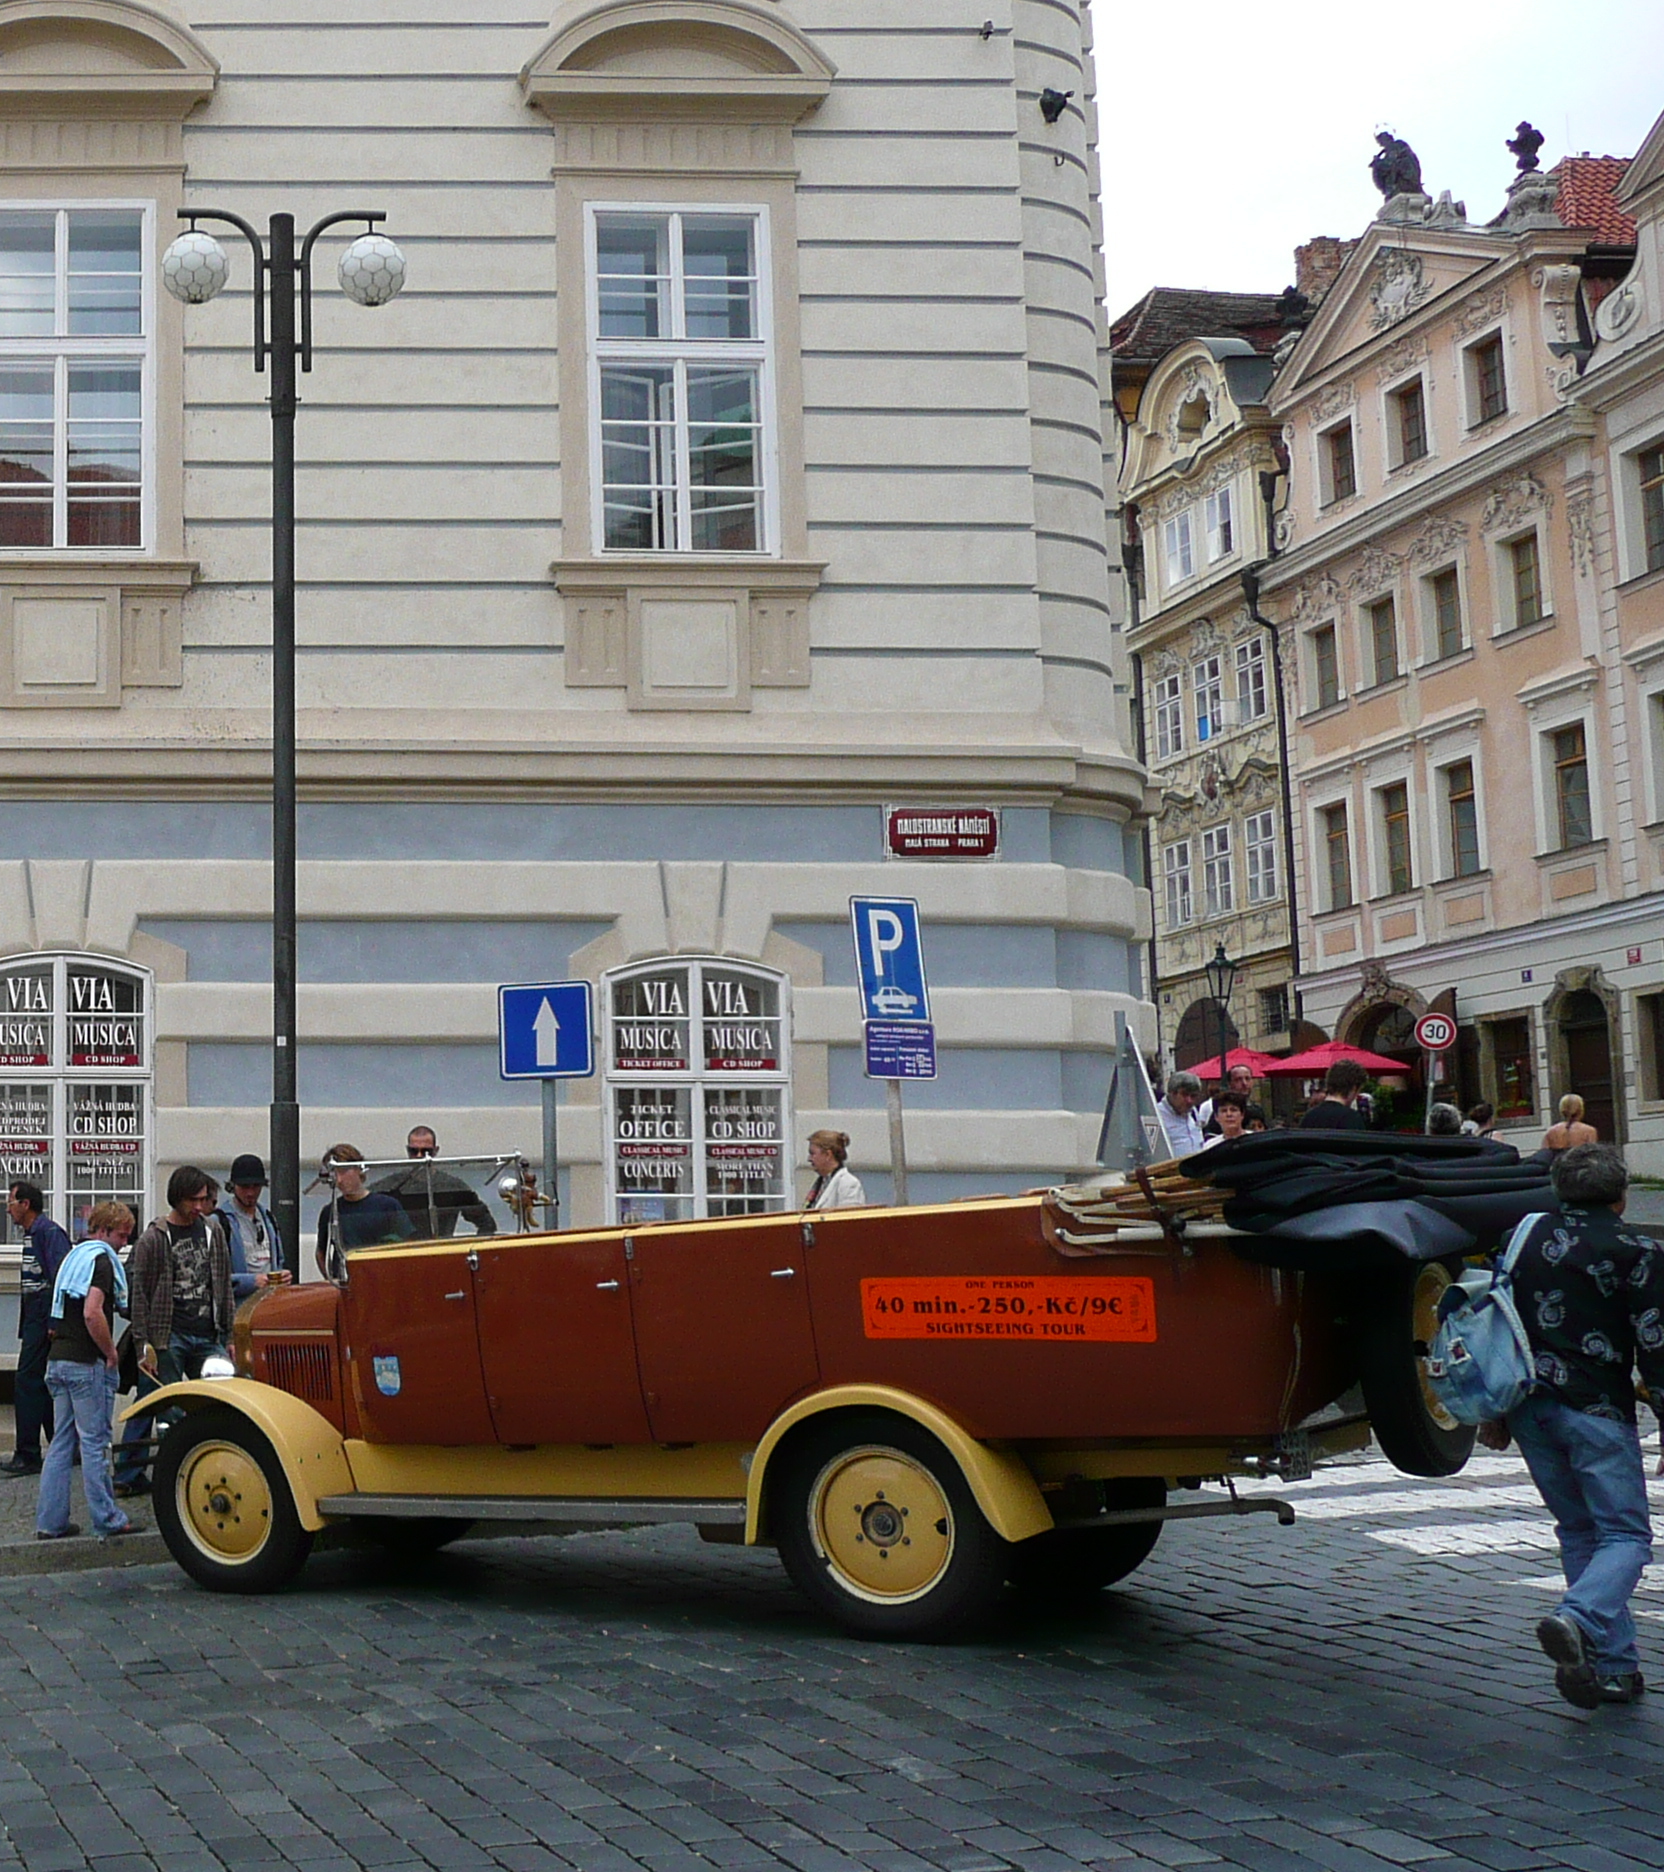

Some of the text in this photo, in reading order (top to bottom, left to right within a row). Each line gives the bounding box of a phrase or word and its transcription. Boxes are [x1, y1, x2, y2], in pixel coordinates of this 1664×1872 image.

[897, 815, 957, 834] MALOSTRANSKÉ
[924, 838, 950, 848] STRANA
[957, 838, 979, 848] PRAHA
[868, 909, 903, 976] P
[6, 977, 48, 1010] VIA
[72, 977, 113, 1010] VIA
[642, 982, 684, 1014] VIA
[707, 982, 749, 1014] VIA
[74, 1023, 136, 1046] MUSICA
[620, 1027, 682, 1050] MUSICA
[711, 1027, 773, 1050] MUSICA
[1424, 1023, 1447, 1040] 30
[9, 1055, 35, 1064] SHOP
[85, 1055, 126, 1064] CD SHOP
[622, 1060, 681, 1068] TICKET OFFICE
[722, 1060, 764, 1068] CD SHOP
[15, 1101, 46, 1111] HUDBA
[105, 1101, 136, 1111] HUDBA
[630, 1105, 674, 1114] TICKET
[709, 1105, 777, 1114] CLASSICAL MUSIC
[73, 1117, 137, 1134] CD SHOP
[620, 1120, 685, 1138] OFFICE
[712, 1121, 776, 1138] CD SHOP
[622, 1146, 685, 1154] CLASSICAL MUSIC
[712, 1147, 745, 1155] CLASSICAL
[624, 1161, 684, 1178] CONCERTS
[716, 1162, 774, 1170] MORE THAN
[739, 1171, 773, 1179] TITLES
[965, 1280, 1035, 1289] ONE PERSON
[875, 1296, 905, 1314] 40
[926, 1321, 1086, 1336] SIGHTSEEING TOUR
